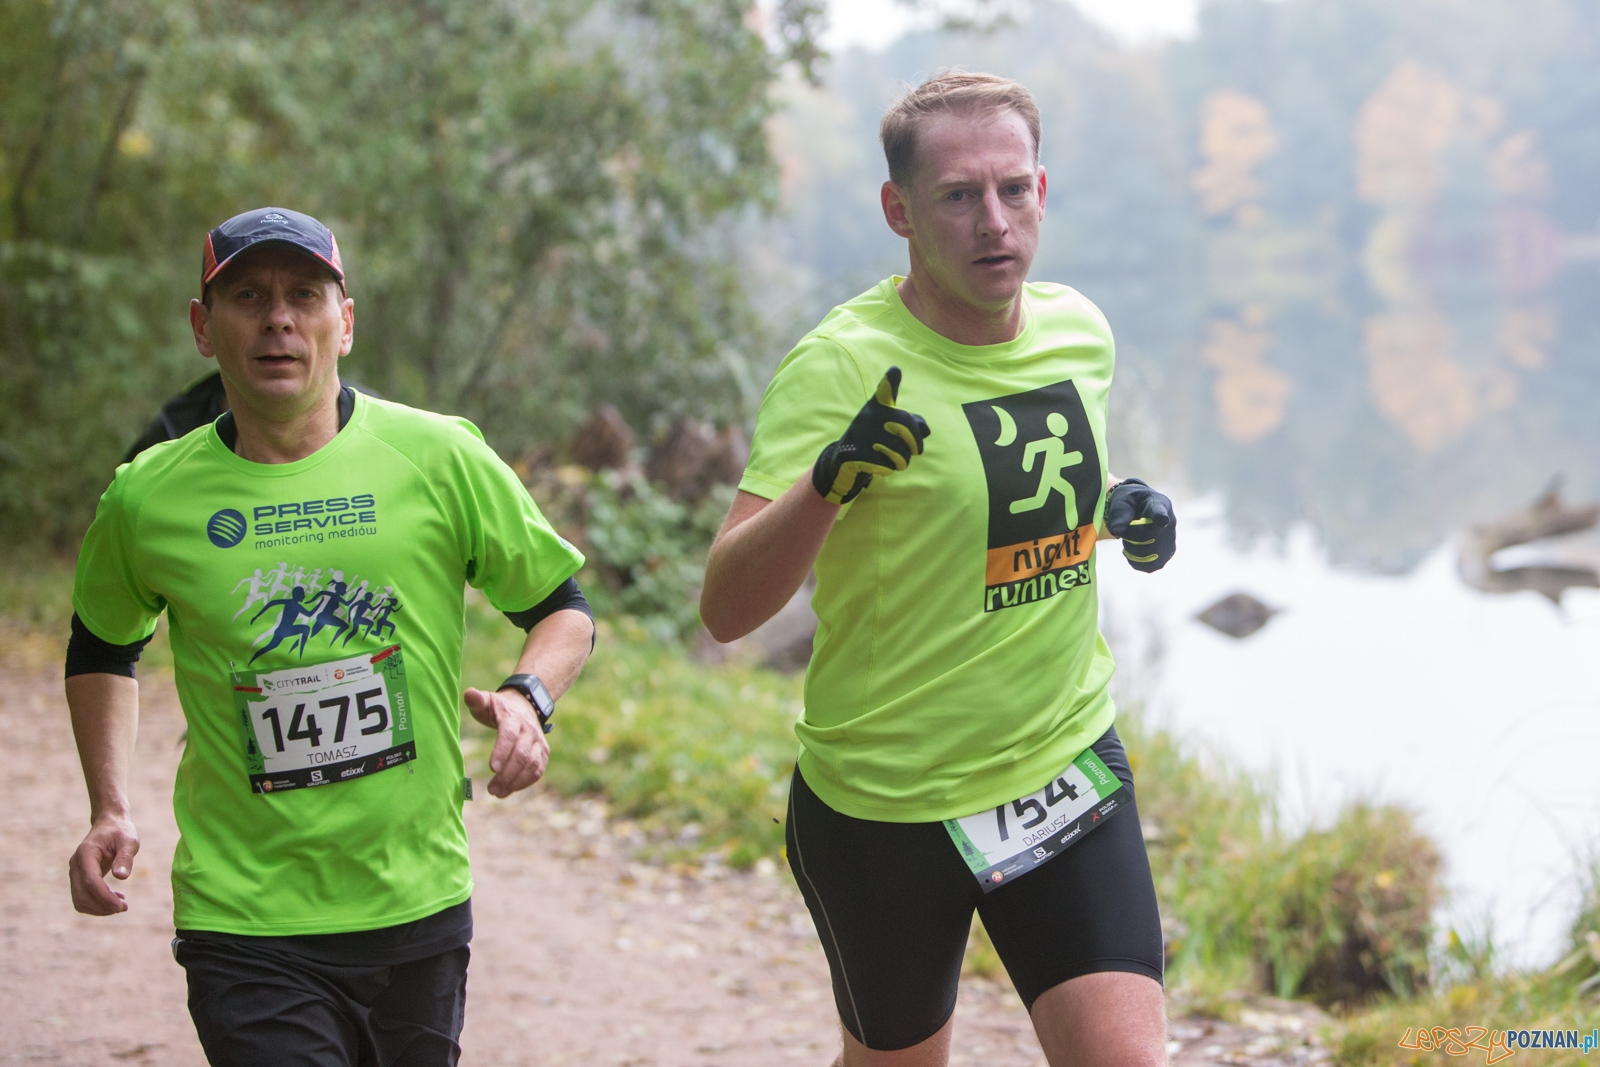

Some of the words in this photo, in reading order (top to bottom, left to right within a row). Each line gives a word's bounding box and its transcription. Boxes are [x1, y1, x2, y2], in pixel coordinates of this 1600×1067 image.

[253, 493, 375, 521] PRESS
[254, 510, 376, 536] SERVICE
[254, 531, 324, 550] monitoring
[328, 524, 377, 540] mediów
[261, 687, 390, 753] 1475
[398, 691, 408, 731] Poznań
[306, 744, 359, 765] TOMASZ
[1082, 757, 1110, 786] Poznań
[994, 776, 1080, 842] 754
[1022, 813, 1071, 847] DARIUSZ
